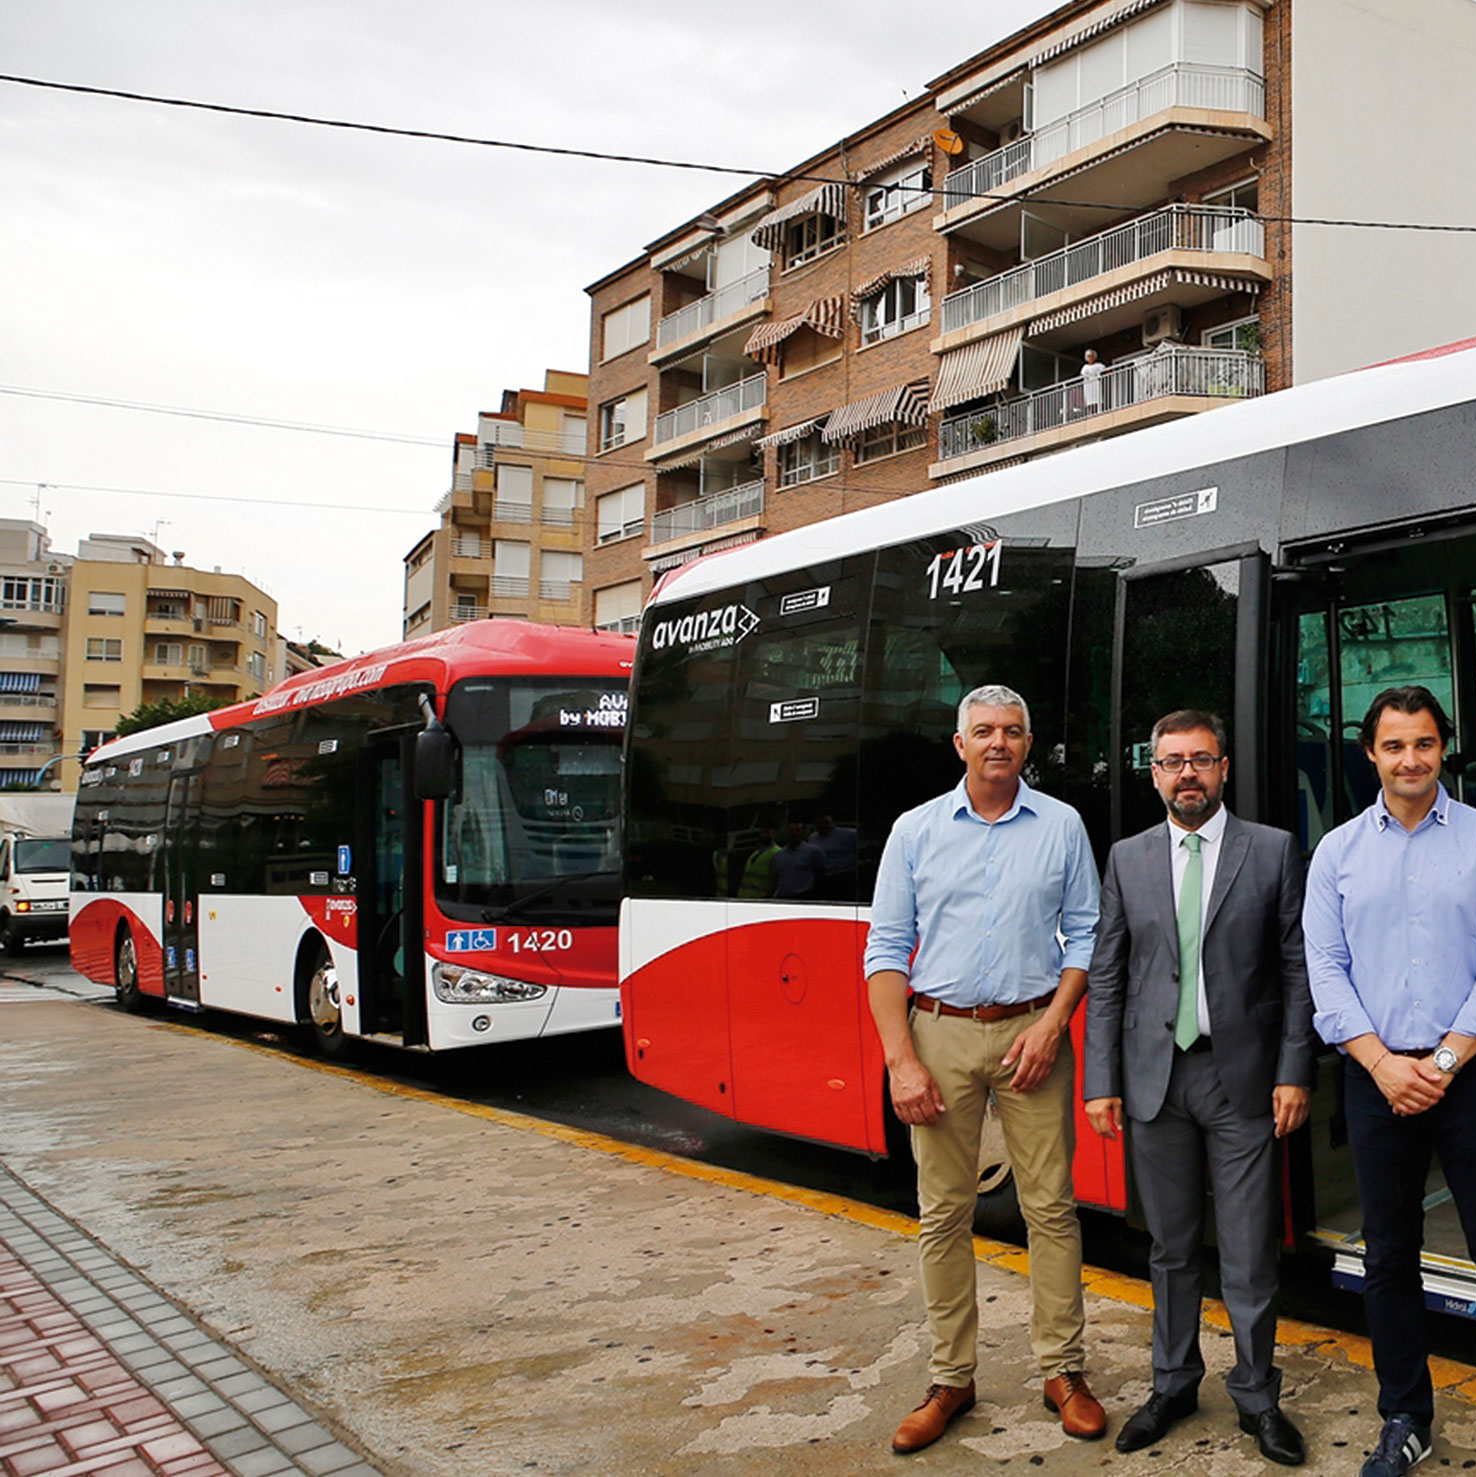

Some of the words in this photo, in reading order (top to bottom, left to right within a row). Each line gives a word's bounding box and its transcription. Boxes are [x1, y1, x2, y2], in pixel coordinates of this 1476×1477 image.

[926, 538, 1003, 600] 1421
[652, 604, 738, 650] avanza
[560, 709, 581, 726] by
[507, 929, 573, 953] 1420
